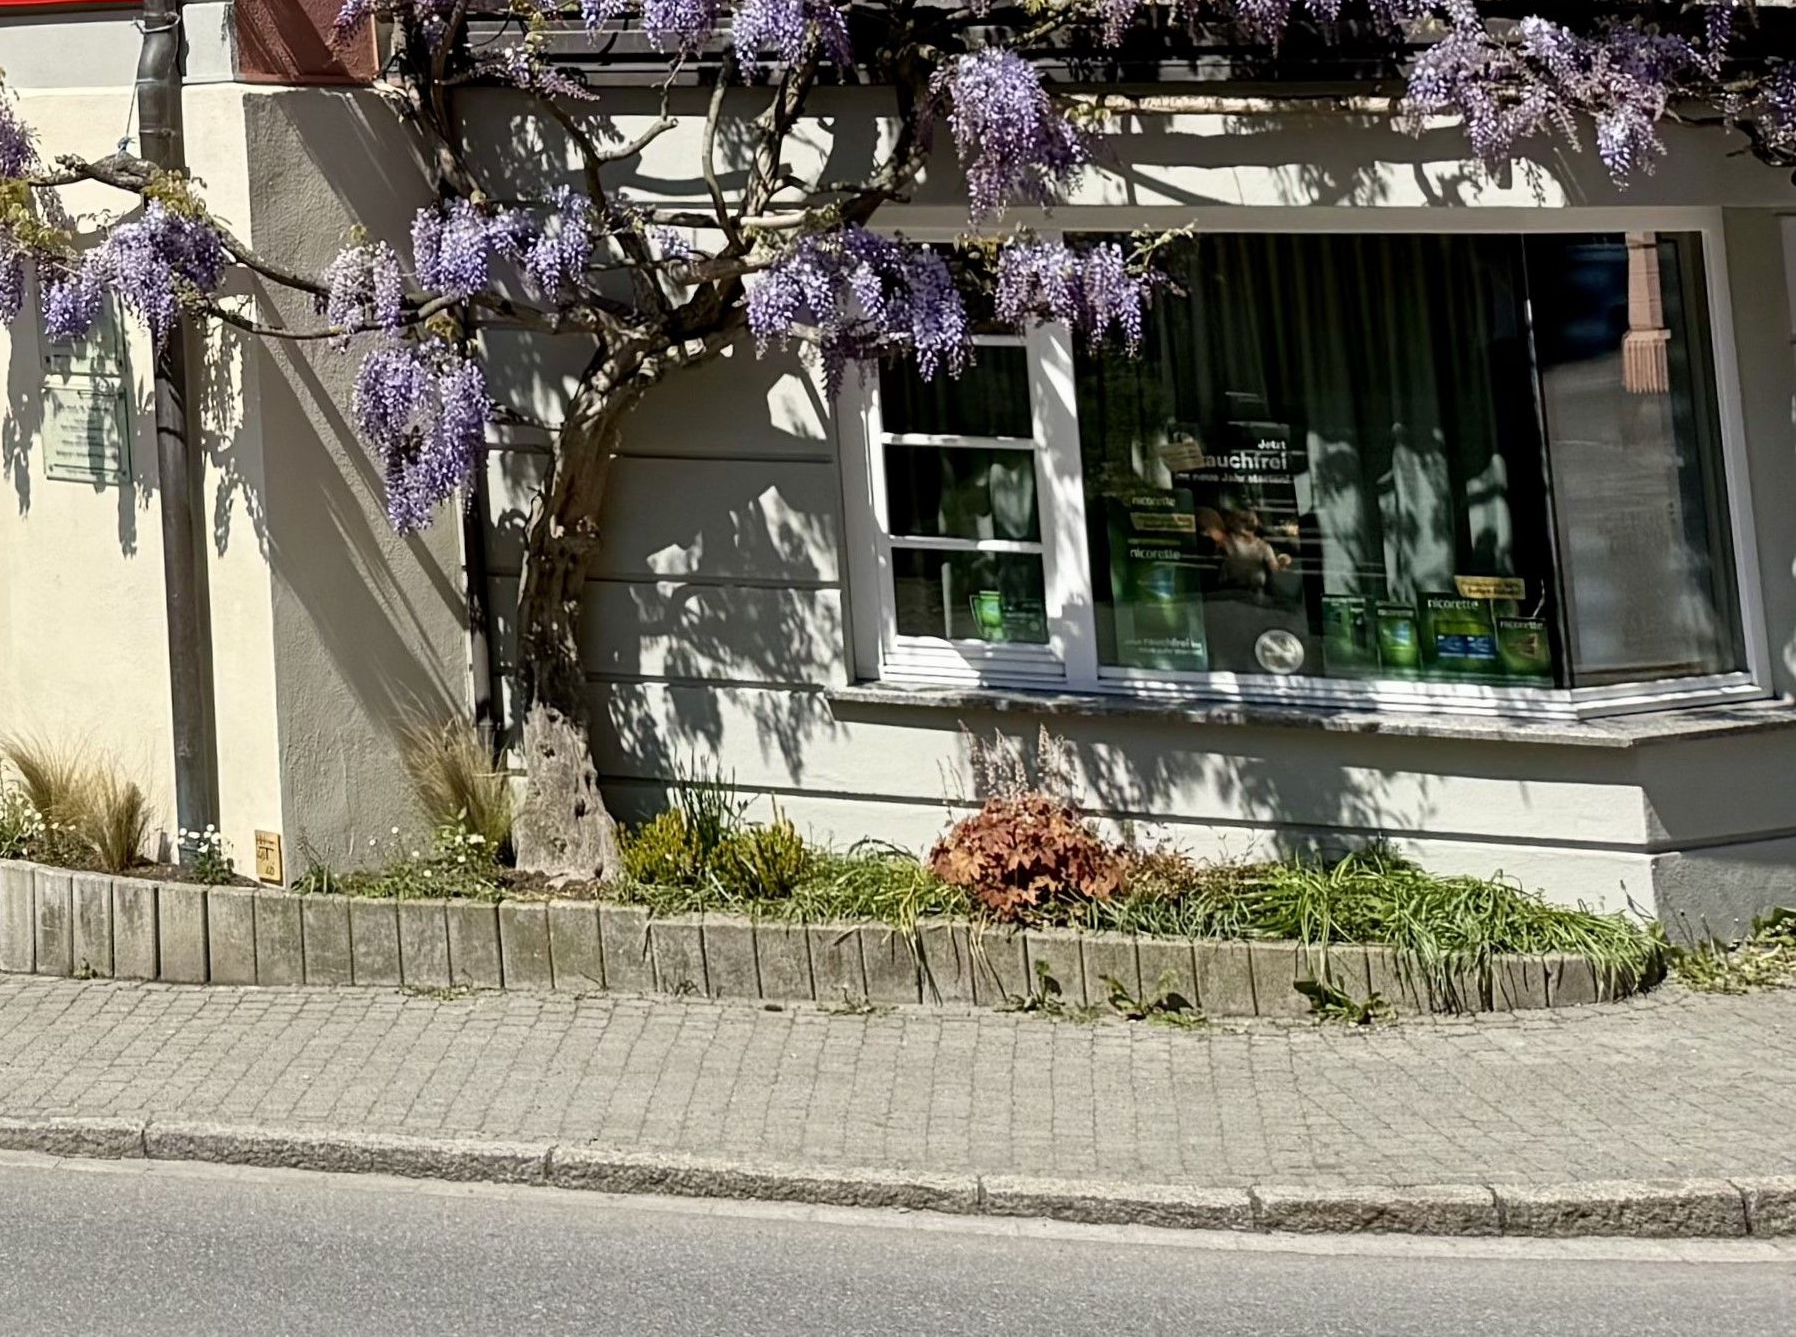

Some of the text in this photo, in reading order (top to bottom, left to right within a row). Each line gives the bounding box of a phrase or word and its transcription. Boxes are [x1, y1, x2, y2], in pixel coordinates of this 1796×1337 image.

[1203, 452, 1287, 471] auchfrei
[1130, 549, 1181, 560] nicorette
[1427, 598, 1479, 610] nicorette
